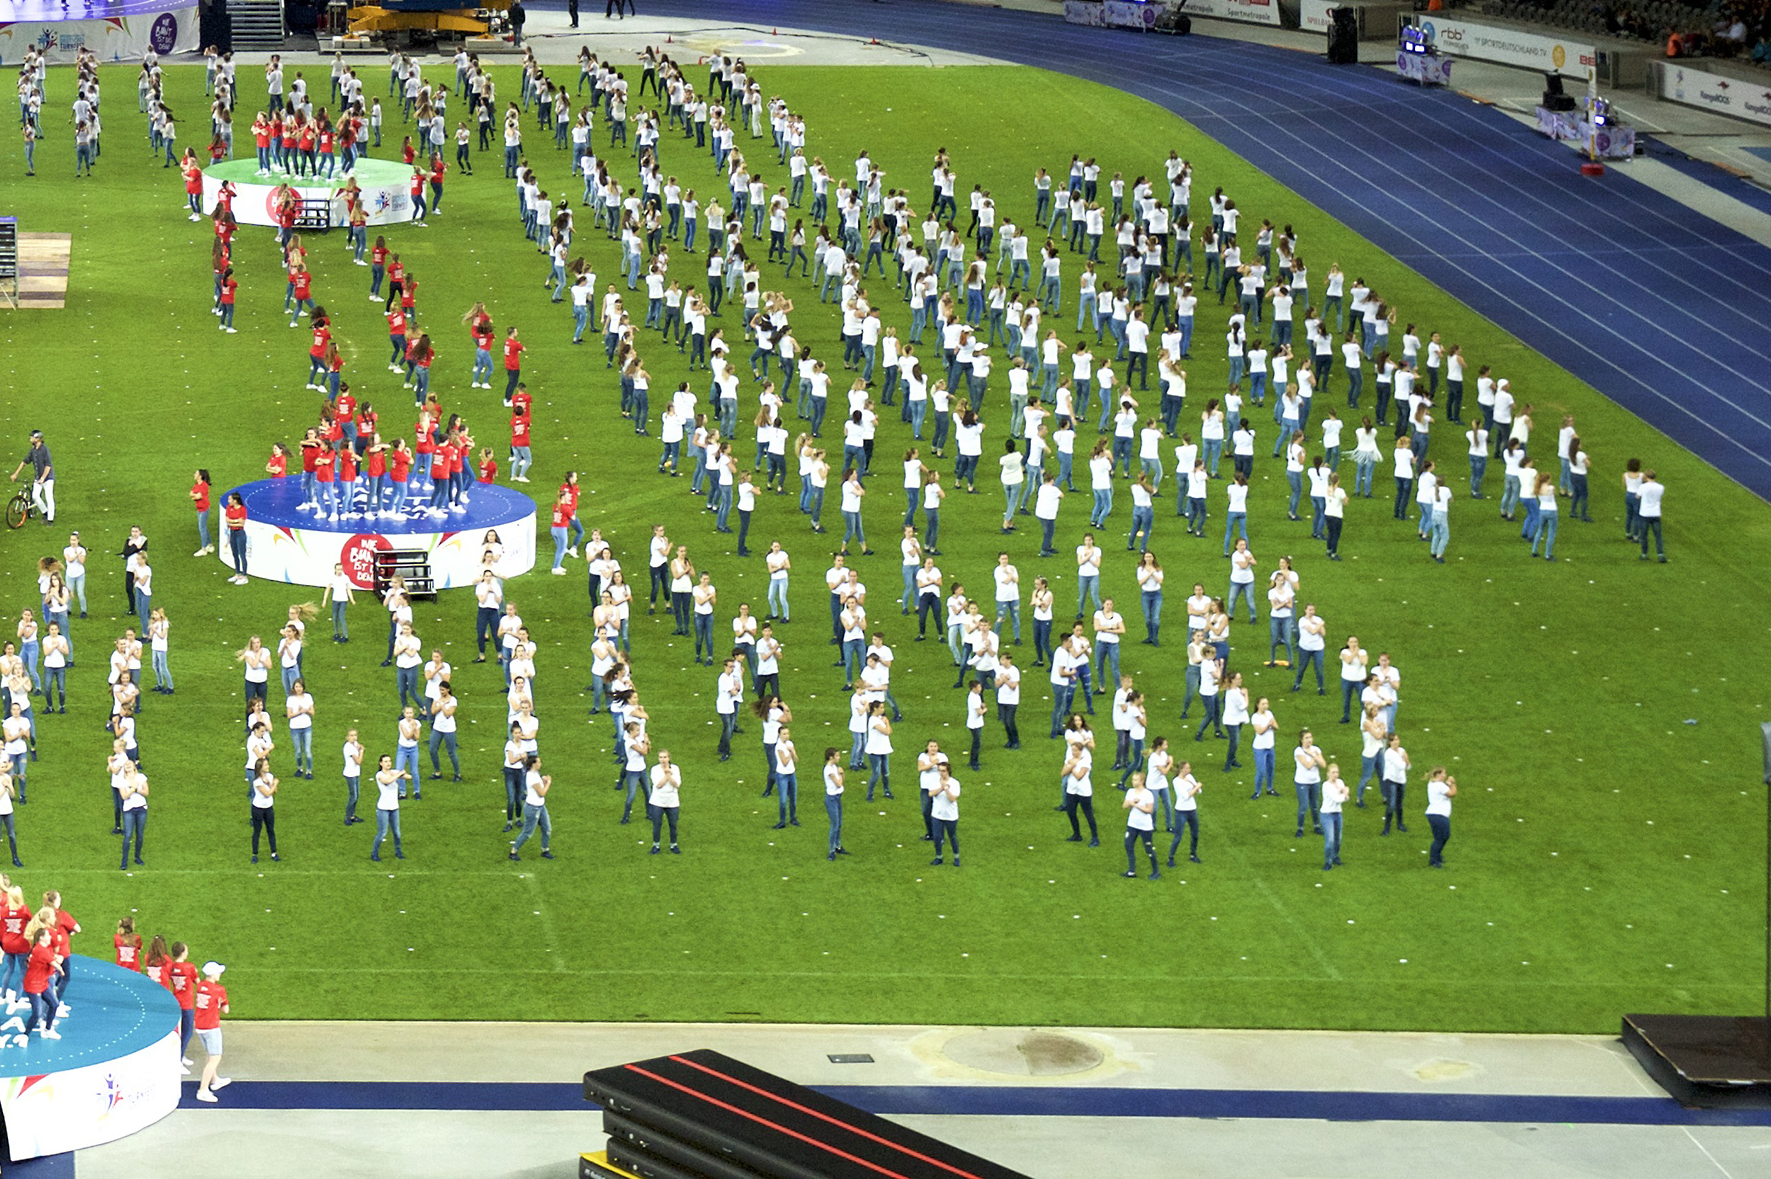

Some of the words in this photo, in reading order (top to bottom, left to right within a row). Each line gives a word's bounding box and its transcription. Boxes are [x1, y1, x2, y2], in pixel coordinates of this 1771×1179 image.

[1227, 8, 1271, 21] Sportmetropole
[1441, 27, 1463, 41] rbb
[361, 539, 378, 551] WIE
